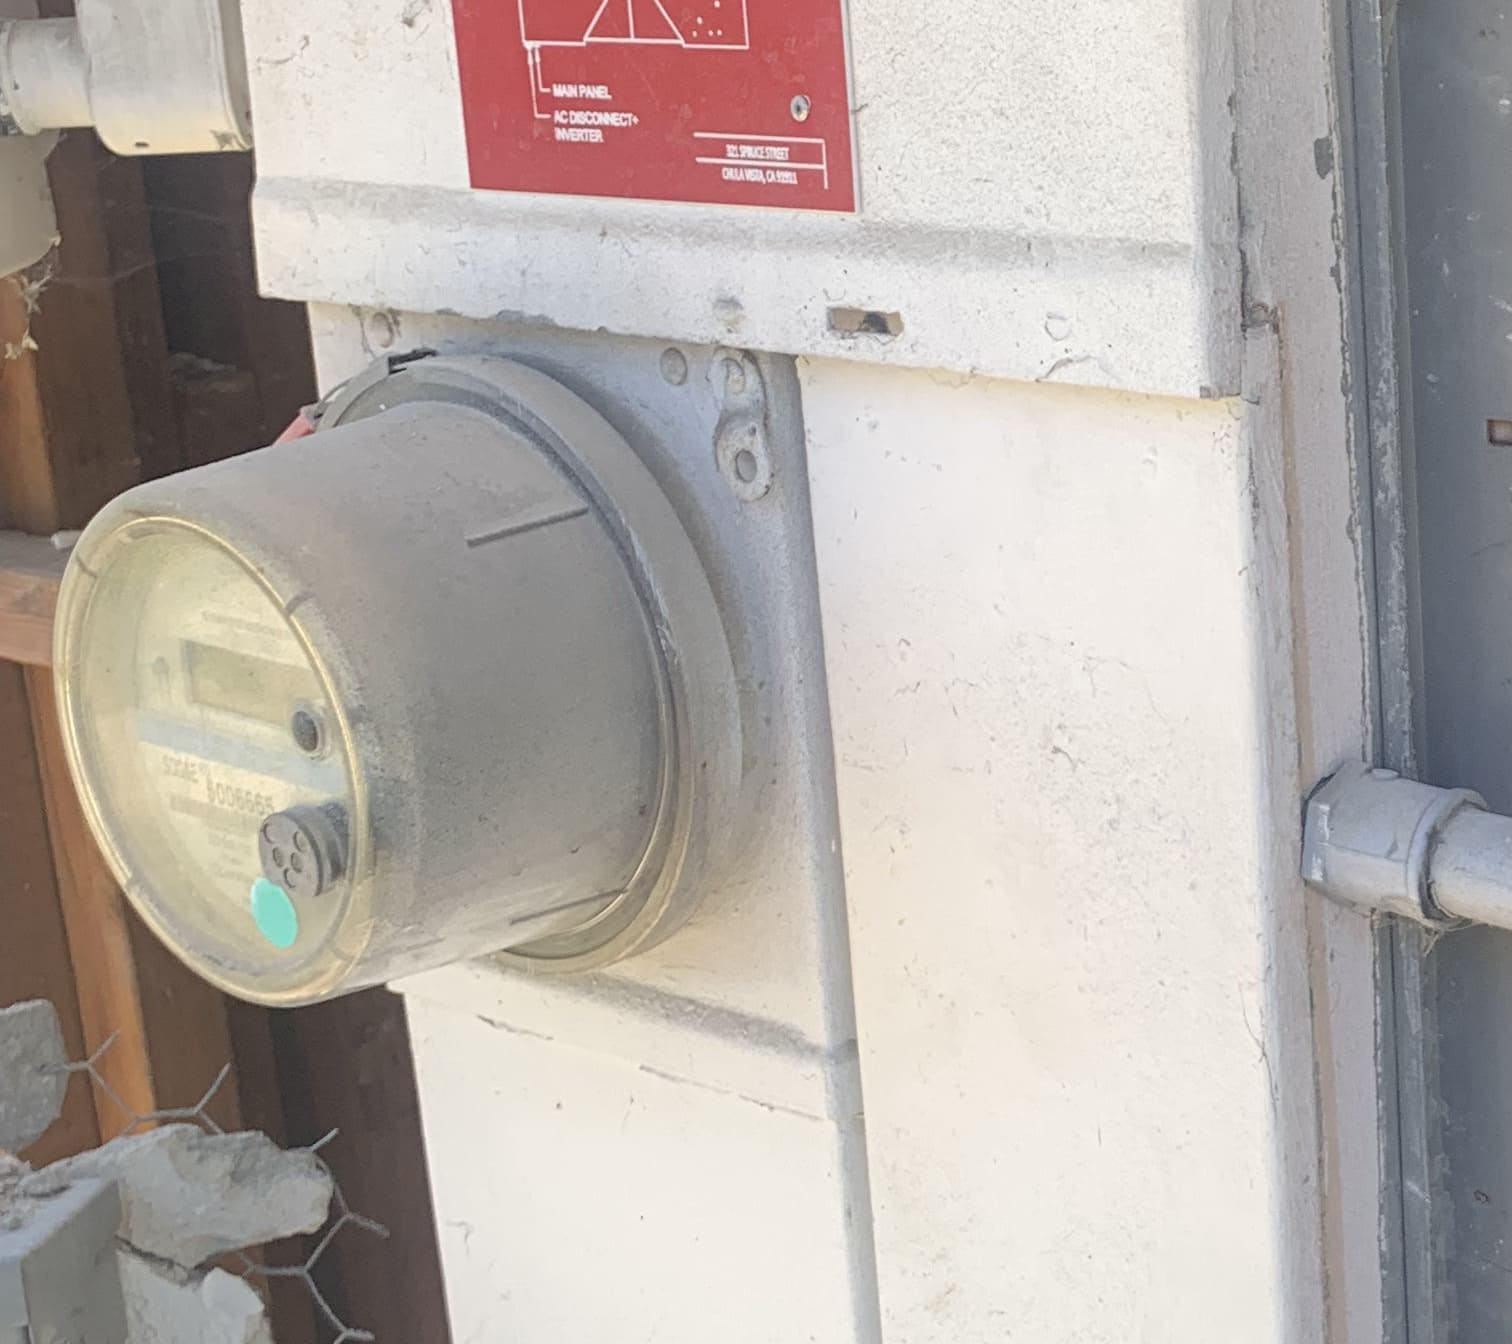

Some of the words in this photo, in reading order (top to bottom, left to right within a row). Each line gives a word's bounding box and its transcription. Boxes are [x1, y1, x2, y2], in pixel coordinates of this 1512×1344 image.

[552, 84, 578, 97] MAIN
[579, 84, 612, 100] PANEL
[554, 114, 568, 124] AC
[554, 127, 604, 142] INVERTER
[767, 171, 776, 182] CA
